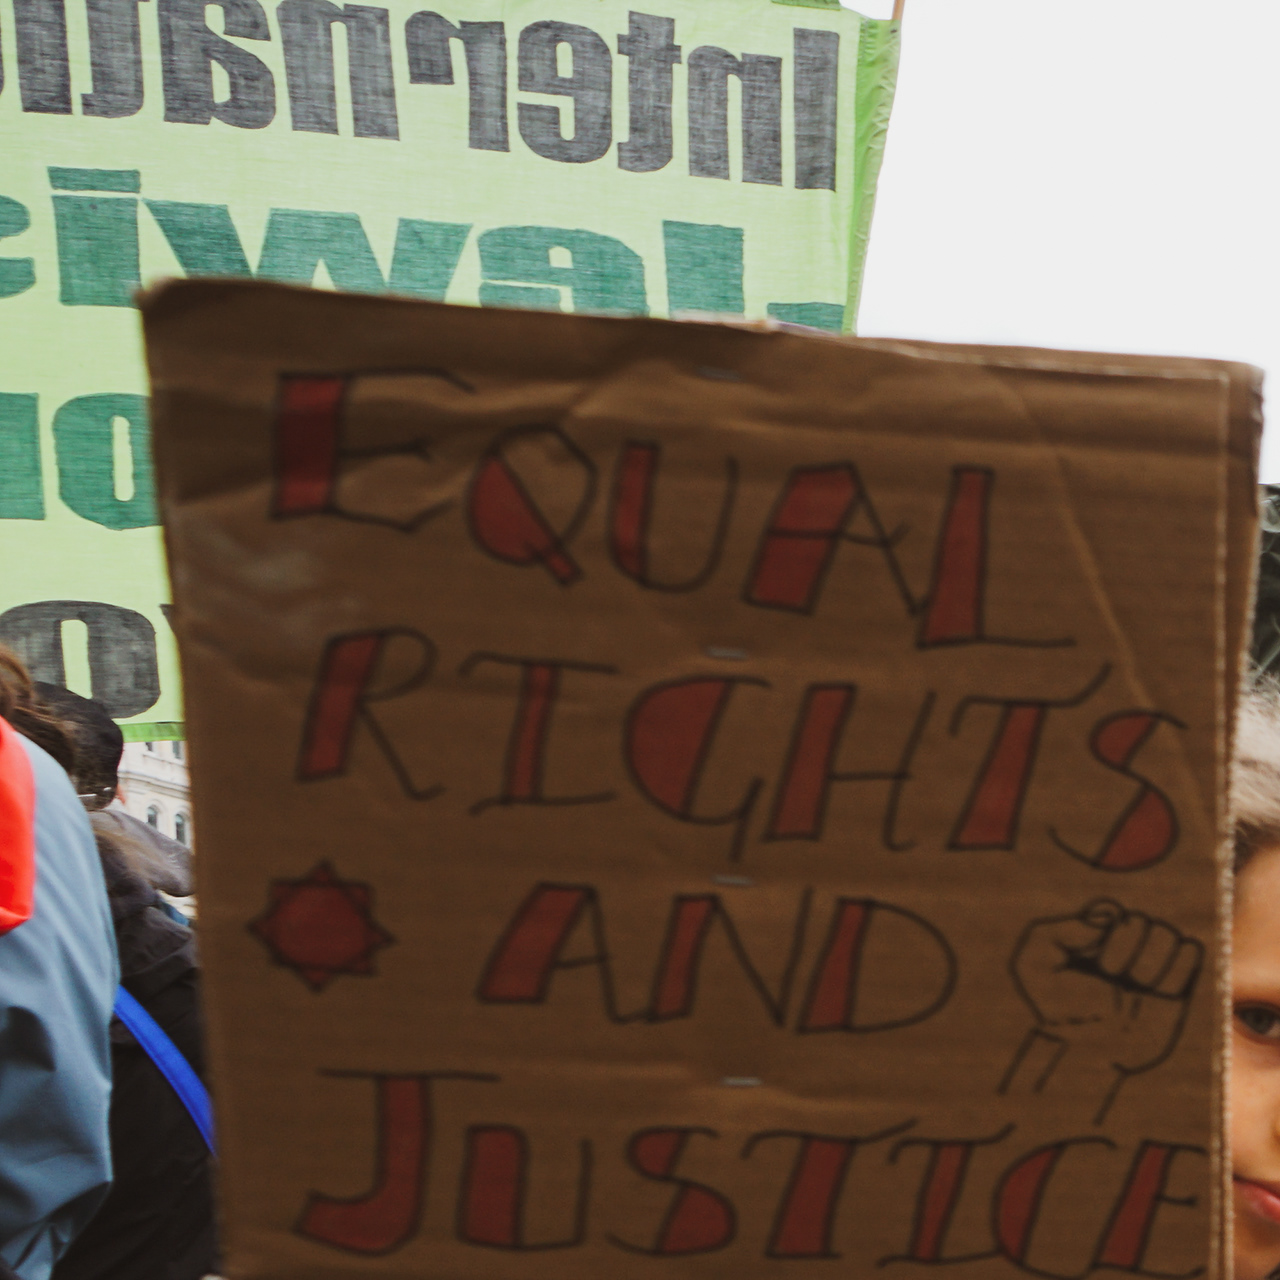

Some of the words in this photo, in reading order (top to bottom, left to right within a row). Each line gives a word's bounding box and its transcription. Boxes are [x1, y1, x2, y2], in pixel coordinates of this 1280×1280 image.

[269, 368, 1077, 649] EQUAL
[294, 626, 1188, 872] RIGHTS
[474, 882, 958, 1034] AND
